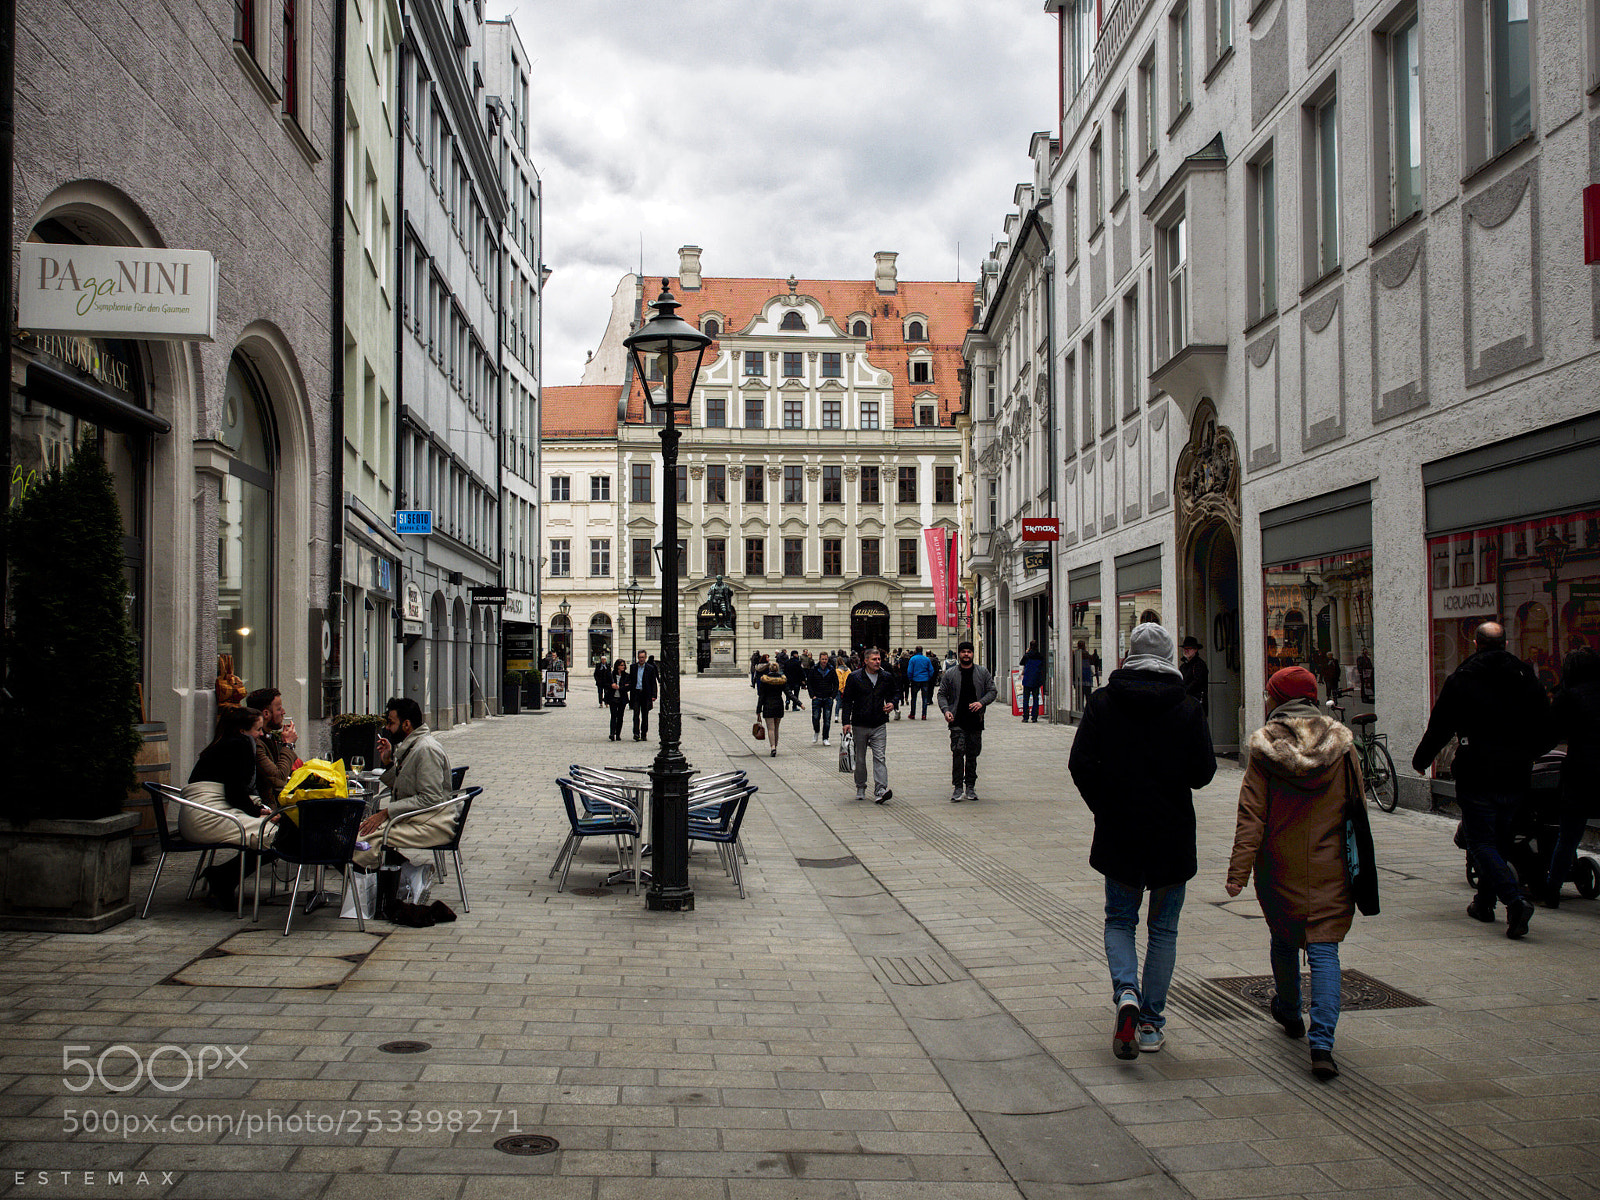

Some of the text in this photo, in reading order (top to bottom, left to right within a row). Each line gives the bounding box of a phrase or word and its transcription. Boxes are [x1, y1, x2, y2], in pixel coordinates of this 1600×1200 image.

[94, 301, 190, 314] Symphonie für den Gaumen
[35, 335, 93, 374] FEINKOST
